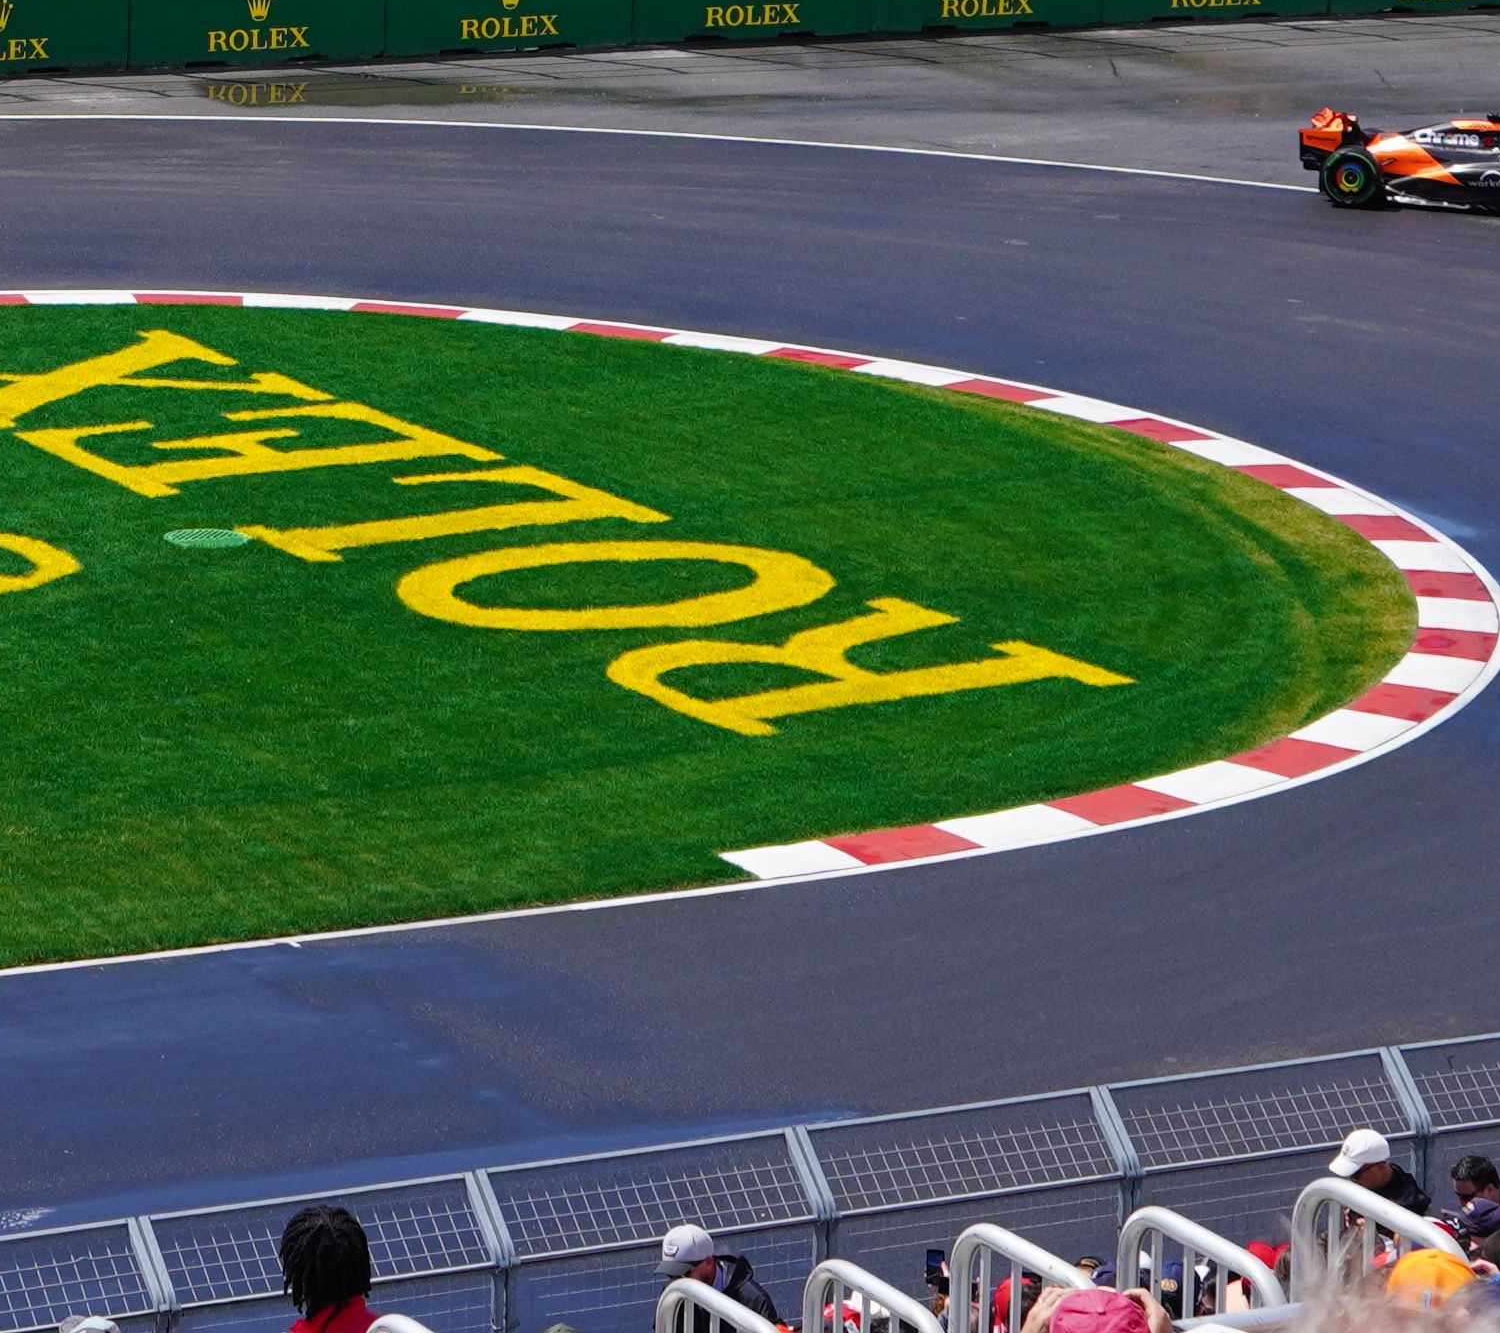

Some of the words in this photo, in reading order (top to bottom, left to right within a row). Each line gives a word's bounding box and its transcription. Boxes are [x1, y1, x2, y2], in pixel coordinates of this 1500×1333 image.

[460, 15, 559, 40] ROLEX
[704, 3, 800, 28] ROLEX
[206, 26, 309, 52] ROLEX
[1415, 129, 1479, 147] Chrome
